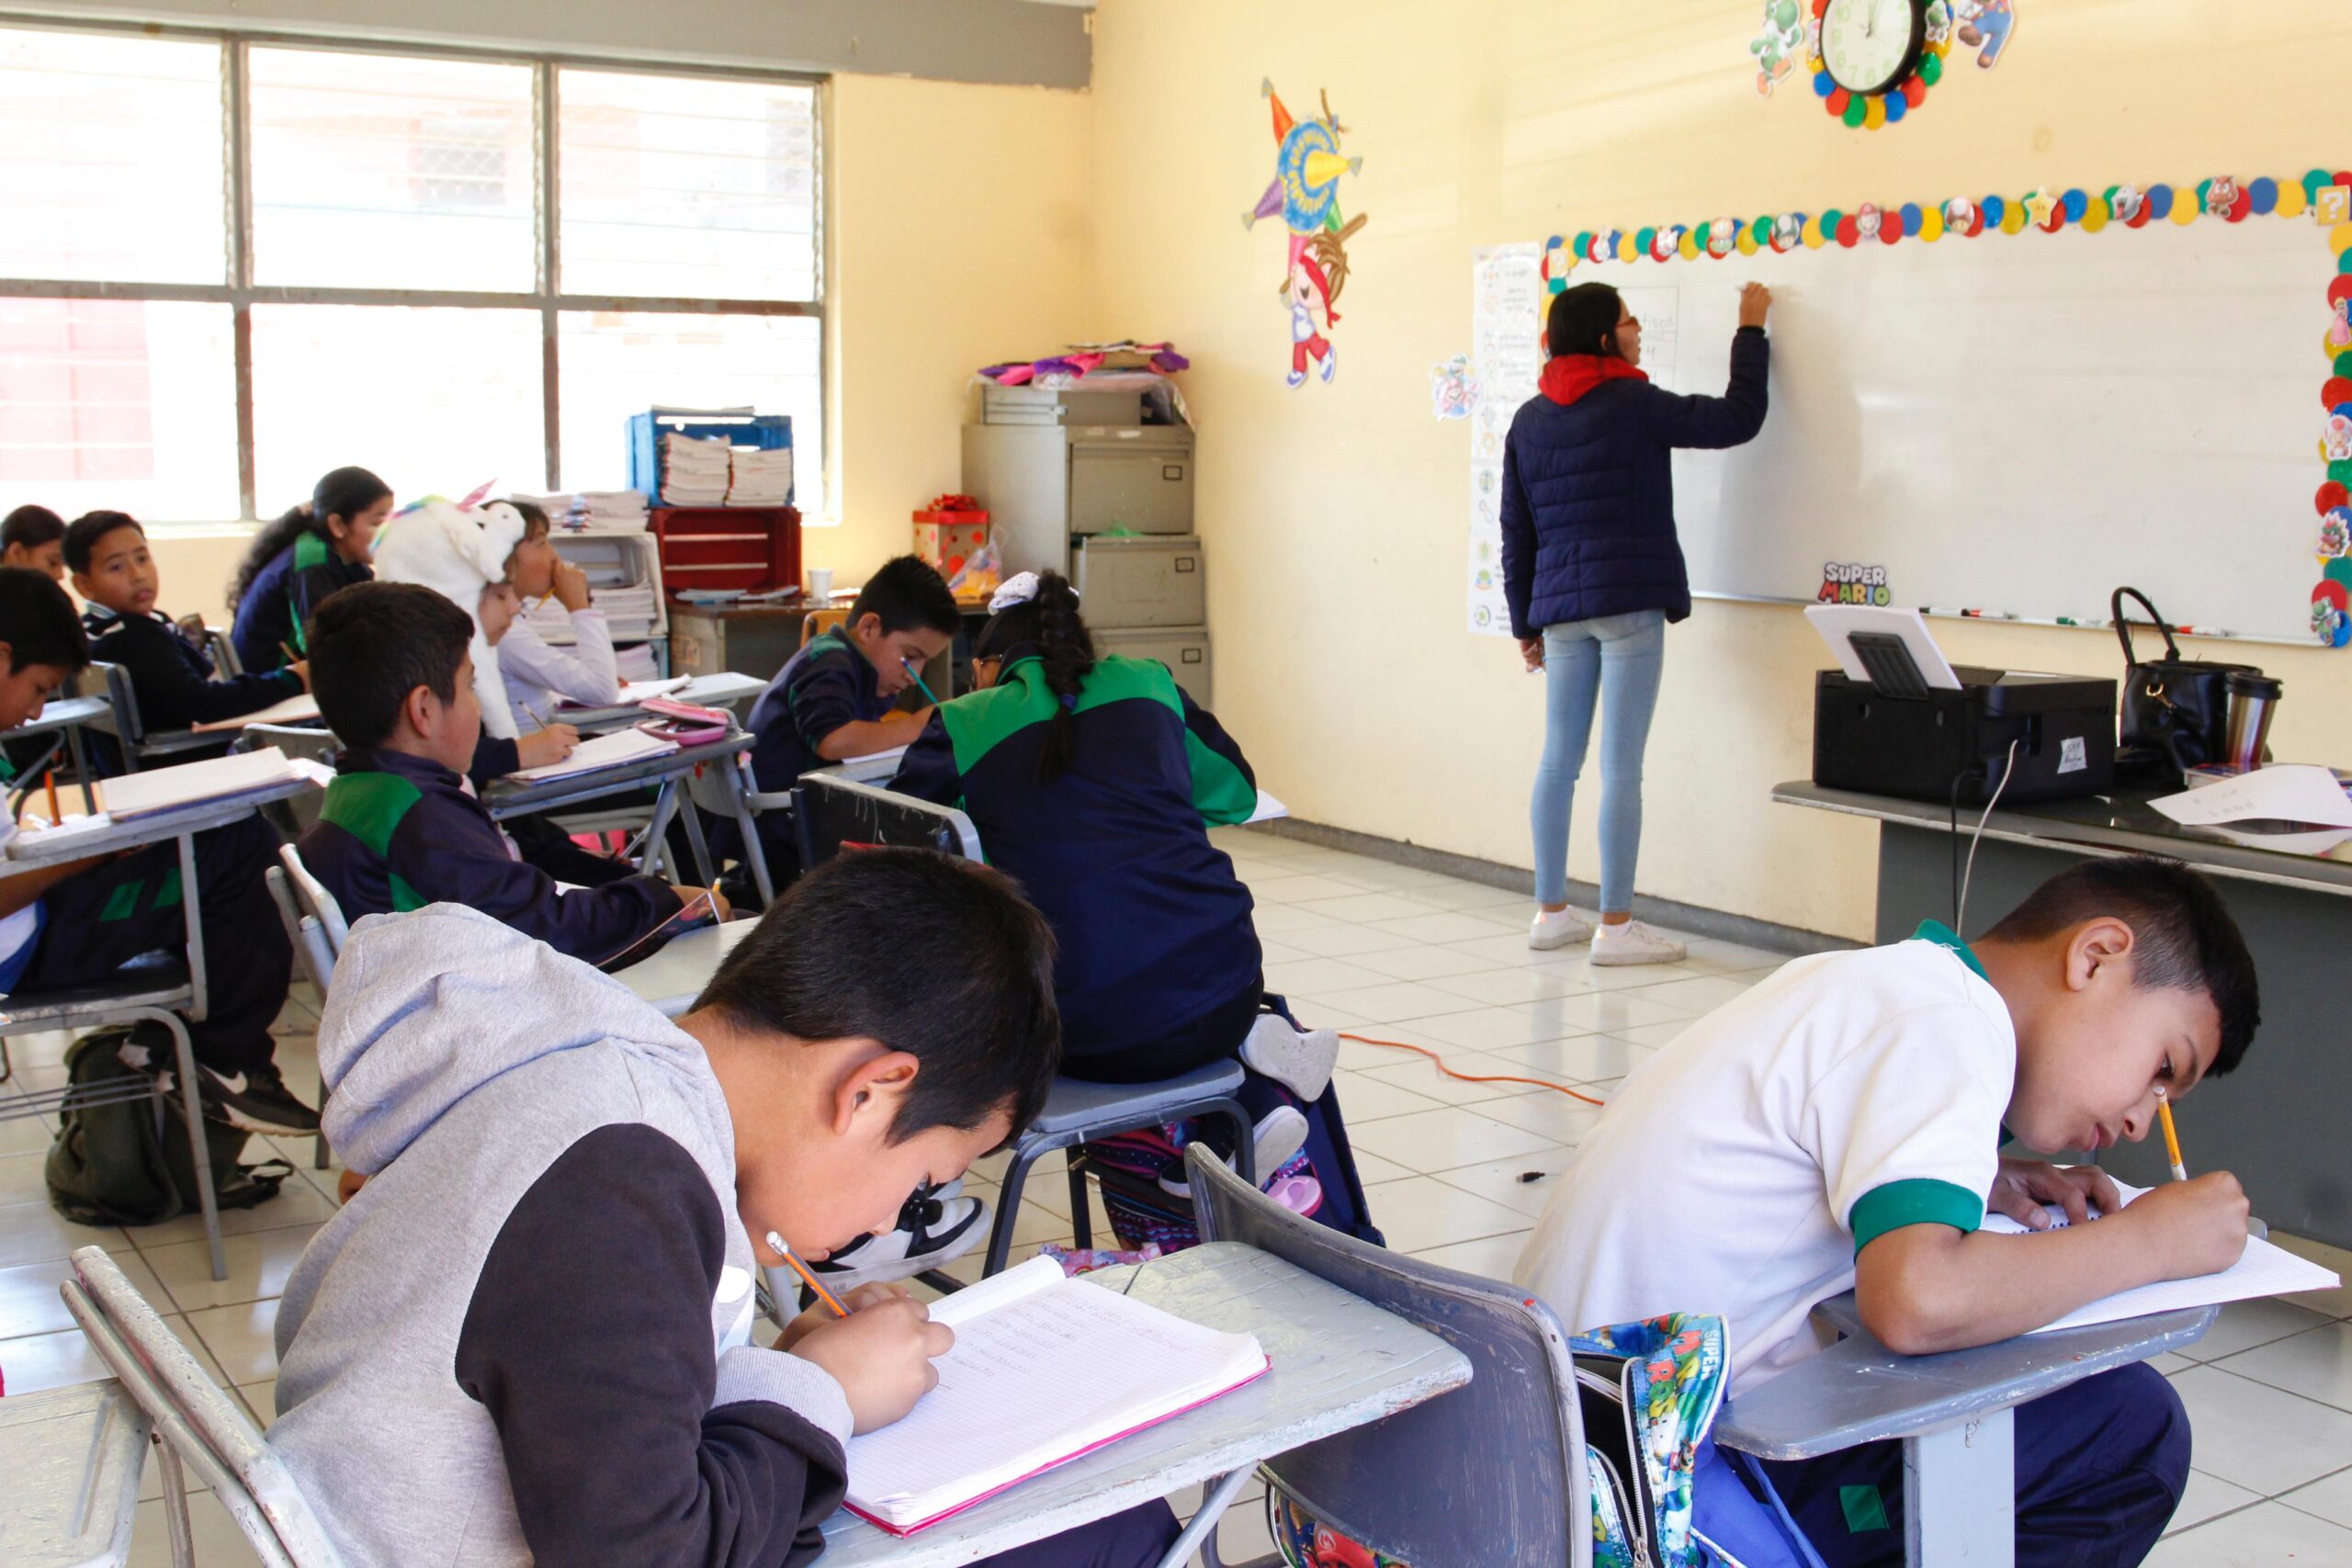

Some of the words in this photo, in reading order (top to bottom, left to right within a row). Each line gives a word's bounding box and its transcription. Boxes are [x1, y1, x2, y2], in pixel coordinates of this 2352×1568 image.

[1837, 4, 1850, 22] 10
[1831, 28, 1842, 46] 9
[1836, 50, 1846, 69] 8
[1849, 63, 1859, 84] 7
[1866, 69, 1875, 85] 6
[1824, 562, 1886, 586] SUPER
[1817, 581, 1891, 606] MARIO
[1701, 1330, 1721, 1381] SUPER
